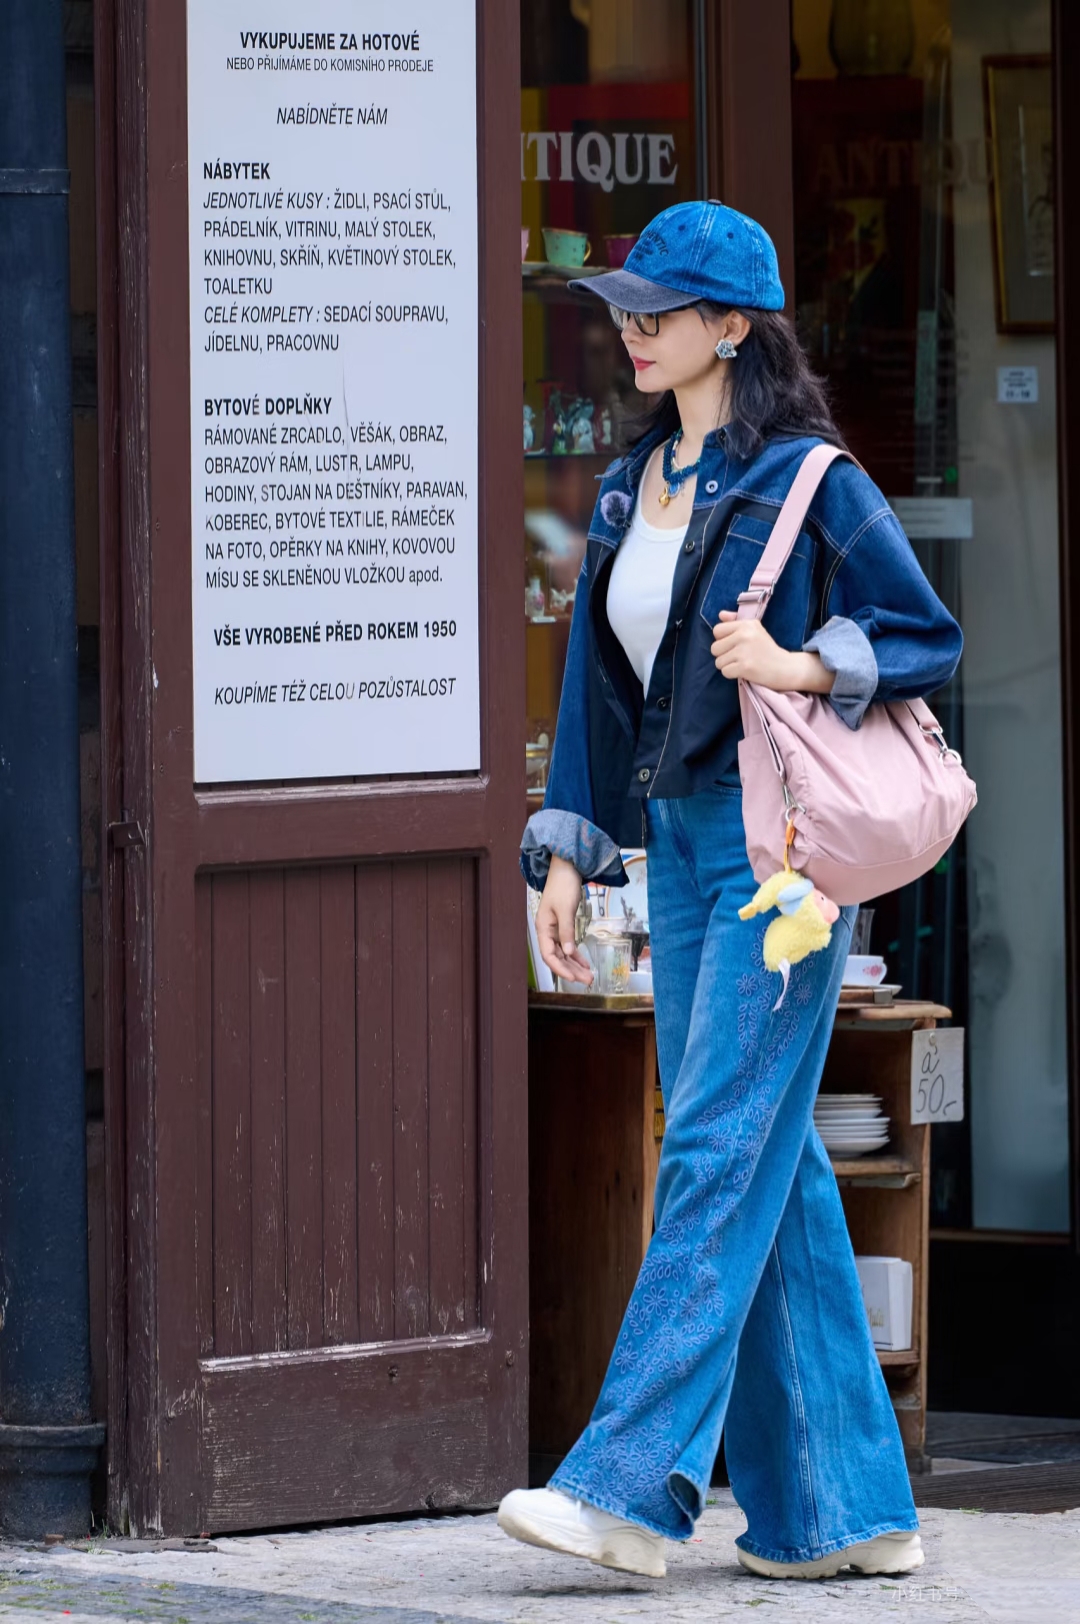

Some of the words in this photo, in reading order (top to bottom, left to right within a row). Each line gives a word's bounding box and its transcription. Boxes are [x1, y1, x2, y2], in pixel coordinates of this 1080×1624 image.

[239, 31, 336, 51] VYKUPUJEME
[339, 32, 359, 51] ZA
[361, 29, 420, 52] HOTOVÉ
[226, 56, 255, 71] NEBO
[257, 53, 312, 71] PŘIJÍMÁME
[313, 58, 328, 72] DO
[330, 55, 386, 72] KOMISNÍHO
[387, 58, 434, 73] PRODEJE
[276, 102, 354, 125] NABÍDNĚTE
[356, 102, 388, 125] NÁM
[203, 157, 271, 181] NÁBYTEK
[521, 131, 678, 193] TIQUE
[202, 187, 284, 210] JEDNOTLIVÉ
[286, 191, 324, 210] KUSY
[333, 187, 370, 213] ŽIDLI,
[373, 188, 411, 210] PSACÍ
[414, 187, 451, 213] STŮL,
[203, 215, 282, 241] PRÁDELNÍK,
[285, 220, 341, 241] VITRINU,
[344, 216, 380, 238] MALÝ
[382, 220, 436, 241] STOLEK,
[204, 248, 276, 269] KNIHOVNU,
[279, 243, 324, 269] SKŘÍŇ,
[327, 244, 400, 266] KVĚTINOVÝ
[402, 248, 456, 269] STOLEK,
[203, 277, 273, 295] TOALETKU
[204, 300, 239, 324] CELÉ
[240, 305, 314, 324] KOMPLETY
[323, 300, 372, 323] SEDACÍ
[375, 304, 449, 326] SOUPRAVU,
[204, 330, 263, 355] JÍDELNU,
[266, 333, 340, 352] PRACOVNU
[204, 393, 260, 417] BYTOVÉ
[265, 392, 333, 416] DOPLŇKY
[204, 422, 278, 446] RÁMOVANÉ
[280, 425, 345, 446] ZRCADLO,
[350, 421, 396, 446] VĚŠÁK,
[399, 424, 448, 445] OBRAZ,
[204, 451, 276, 475] OBRAZOVÝ
[279, 450, 312, 476] RÁM,
[315, 453, 362, 475] LUSTR,
[365, 453, 414, 473] LAMPU,
[204, 484, 257, 505] HODINY,
[260, 483, 311, 503] STOJAN
[315, 482, 333, 501] NA
[336, 477, 403, 502] DEŠTNÍKY,
[406, 480, 468, 501] PARAVAN,
[205, 512, 272, 534] KOBEREC,
[275, 506, 326, 530] BYTOVÉ
[328, 509, 388, 530] TEXTILIE,
[391, 504, 455, 527] RÁMEČEK
[205, 542, 224, 560] NA
[227, 540, 266, 562] FOTO,
[269, 535, 323, 559] OPĚRKY
[326, 539, 344, 557] NA
[347, 538, 389, 558] KNIHY,
[392, 536, 456, 555] KOVOVOU
[205, 566, 239, 589] MÍSU
[242, 569, 260, 588] SE
[262, 563, 341, 588] SKLENĚNOU
[344, 561, 405, 585] VLOŽKOU
[408, 565, 443, 587] apod.
[213, 623, 241, 647] VŠE
[244, 620, 321, 646] VYROBENÉ
[325, 619, 363, 643] PŘED
[367, 620, 419, 641] ROKEM
[423, 619, 457, 639] 1950
[214, 680, 278, 706] KOUPÍME
[281, 678, 307, 703] TÉŽ
[309, 682, 355, 702] CELOU
[358, 675, 457, 700] POZŮSTALOST
